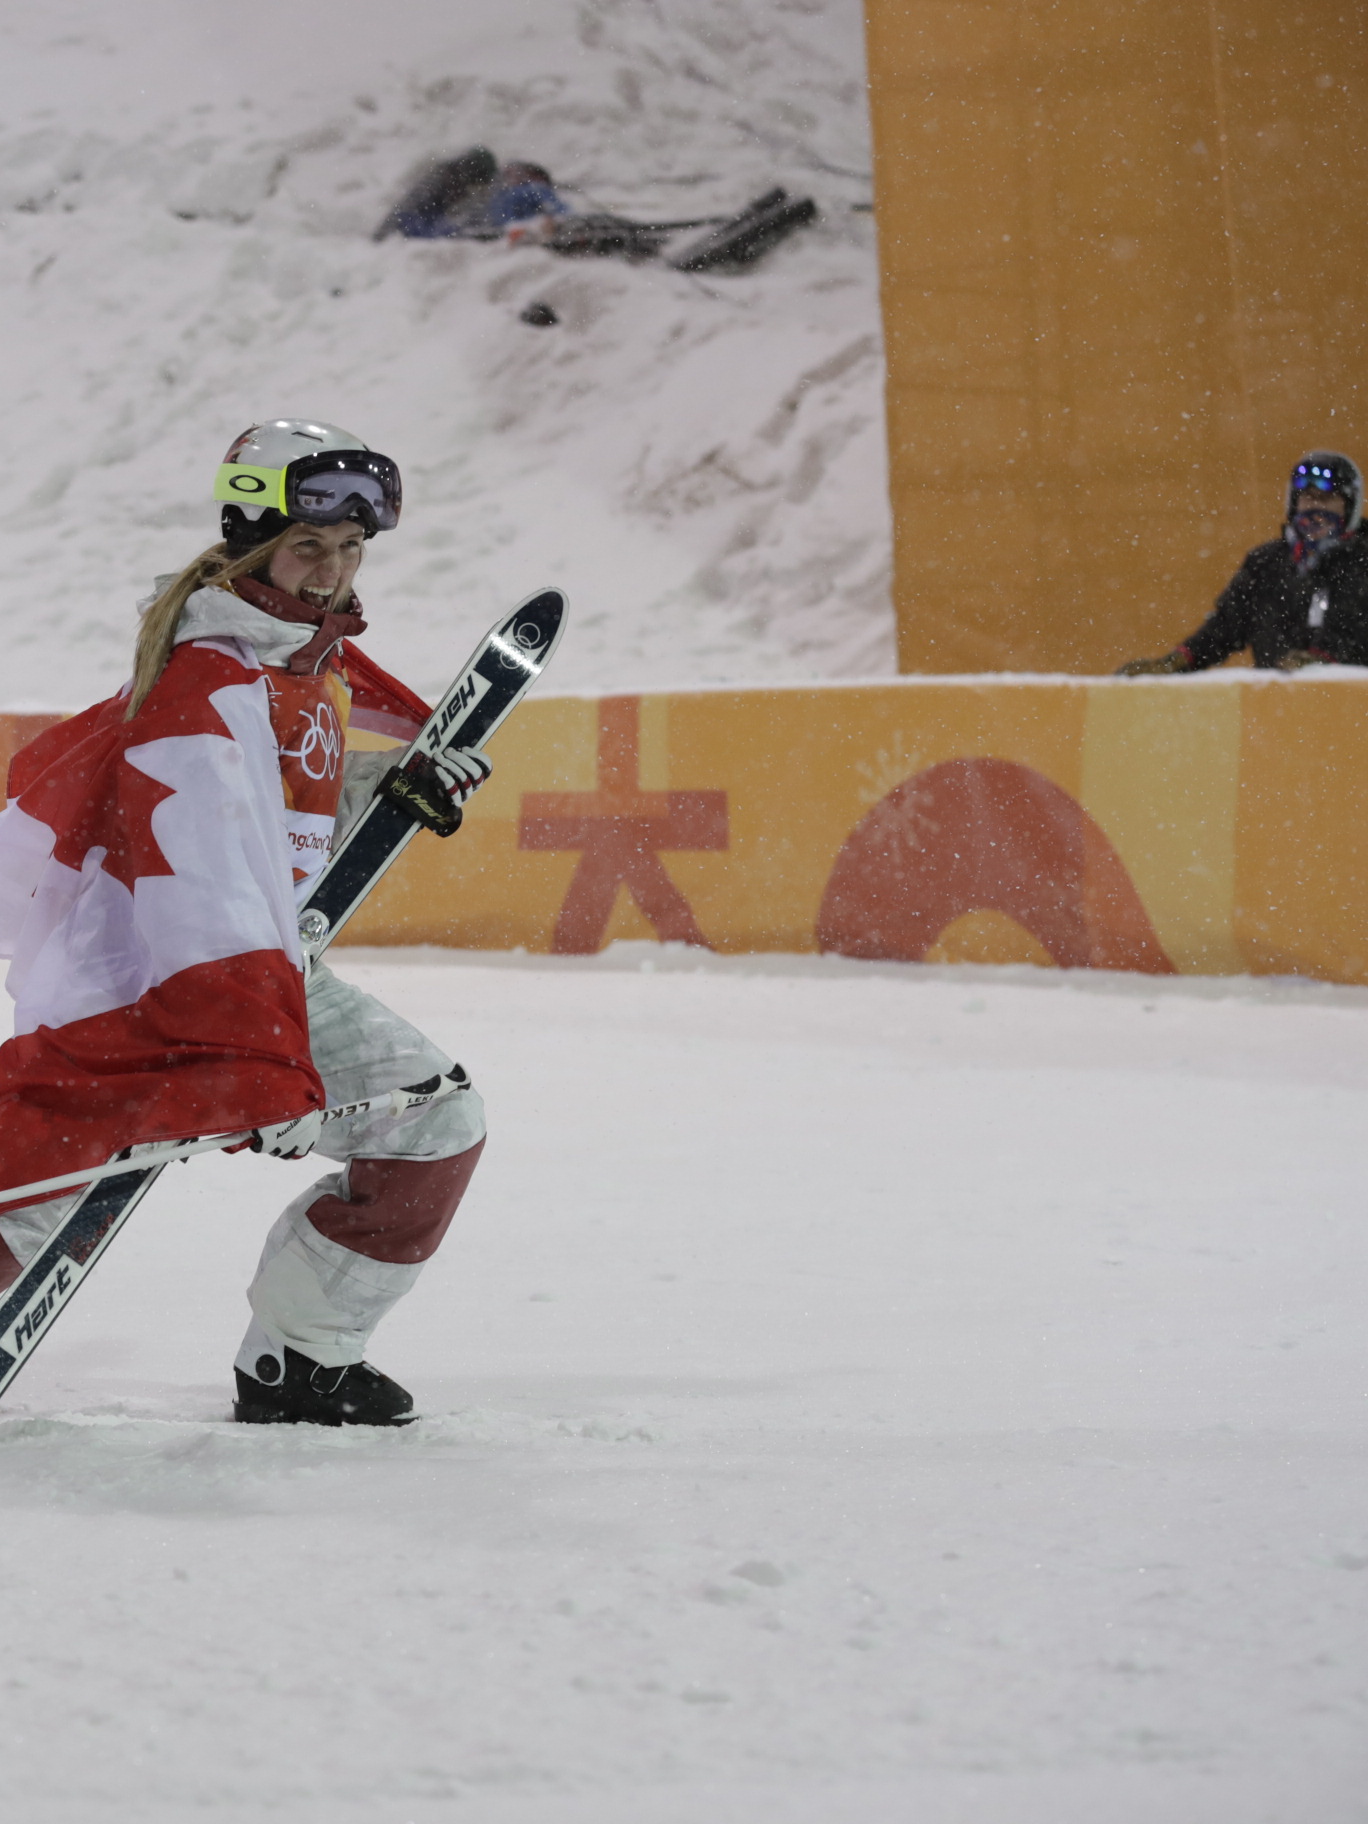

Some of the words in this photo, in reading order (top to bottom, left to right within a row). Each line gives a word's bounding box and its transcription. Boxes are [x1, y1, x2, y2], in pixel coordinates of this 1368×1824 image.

[427, 674, 476, 751] Hart
[321, 1101, 370, 1125] LEKI
[408, 1095, 434, 1104] LEKI
[14, 1264, 72, 1354] Hart
